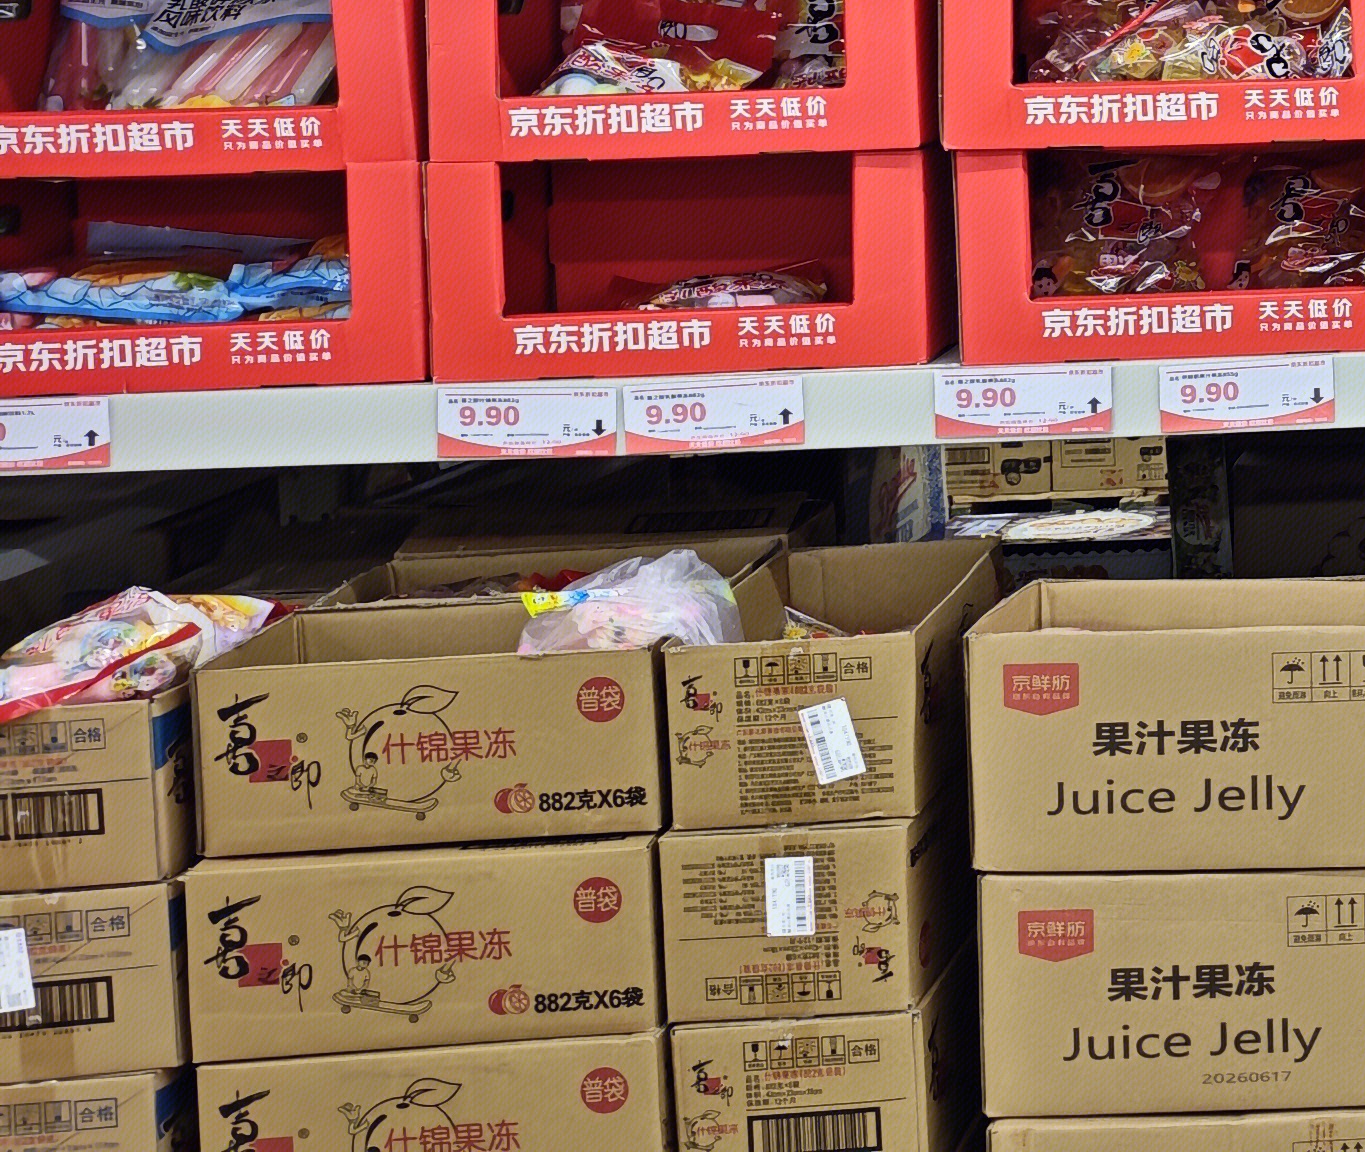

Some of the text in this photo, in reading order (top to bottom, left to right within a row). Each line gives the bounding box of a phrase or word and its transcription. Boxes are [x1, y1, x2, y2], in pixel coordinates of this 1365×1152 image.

[730, 97, 827, 117] 天天低价
[1024, 92, 1218, 124] 京东折扣超市
[1245, 87, 1340, 108] 天天低价
[221, 118, 321, 138] 天天低价
[509, 102, 704, 137] 京东折扣超市
[0, 122, 195, 155] 京东折扣超市
[1043, 304, 1233, 338] 京东折扣超市
[1259, 299, 1352, 320] 天天低价
[738, 314, 836, 335] 天天低价
[230, 329, 331, 351] 天天低价
[514, 319, 712, 355] 京东折扣超市
[0, 335, 202, 373] 京东折扣超市
[956, 388, 1016, 409] 9.90
[1180, 382, 1240, 405] 9.90
[460, 406, 520, 426] 9.90
[646, 403, 707, 424] 9.90
[841, 660, 870, 677] 合格
[1012, 674, 1070, 692] 京鲜舫
[580, 685, 625, 712] 普袋
[73, 727, 102, 744] 合格
[382, 727, 517, 766] 什锦果冻
[1092, 719, 1260, 757] 果汁果冻
[538, 786, 647, 813] 882克X6袋
[1047, 775, 1306, 820] Juice Jelly
[576, 886, 619, 912] 普袋
[90, 914, 125, 932] 合格
[1027, 921, 1085, 938] 京鲜舫
[375, 929, 512, 967] 什锦果冻
[1107, 962, 1275, 1002] 果汁果冻
[534, 987, 645, 1014] 882克X6袋
[852, 1043, 878, 1058] 合格
[1063, 1018, 1322, 1063] Juice Jelly
[1202, 1070, 1291, 1085] 20260617
[582, 1076, 626, 1103] 普袋
[79, 1107, 114, 1123] 合格
